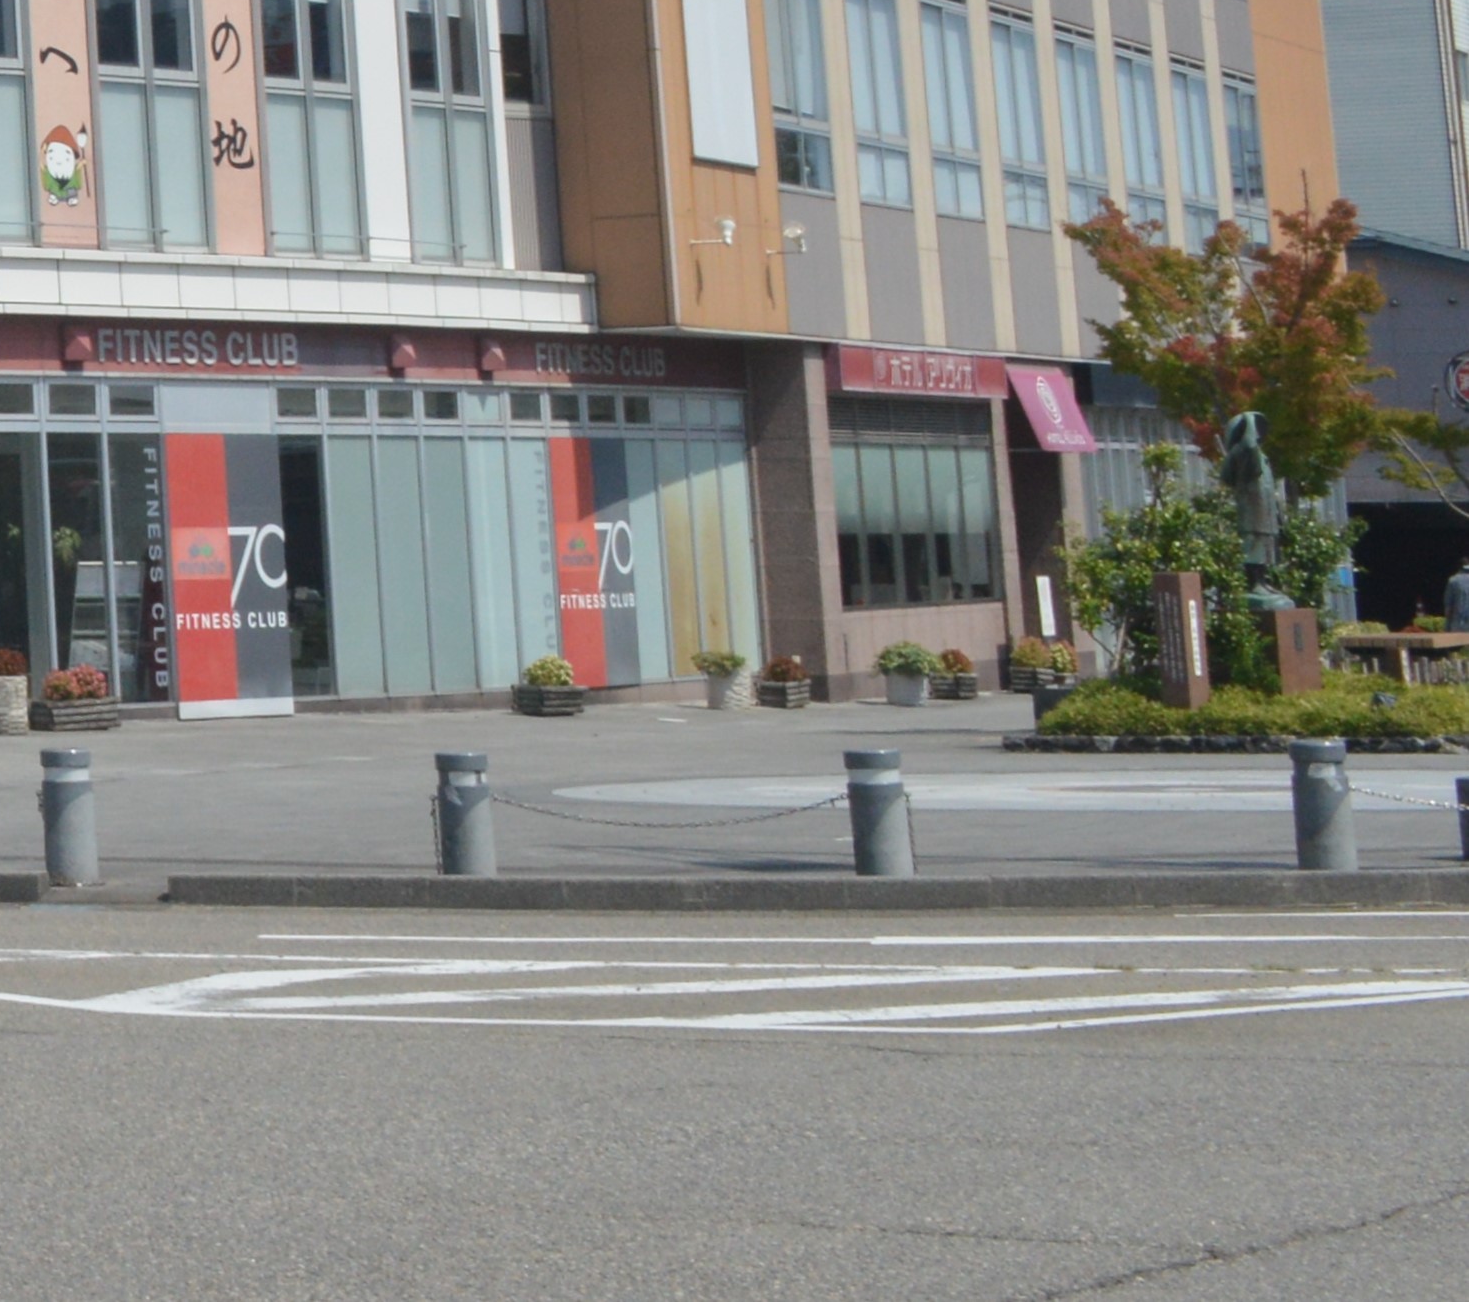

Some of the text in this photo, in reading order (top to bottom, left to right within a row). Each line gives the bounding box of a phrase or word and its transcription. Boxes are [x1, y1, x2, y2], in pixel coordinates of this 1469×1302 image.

[97, 327, 299, 368] FITNESS CLUB
[535, 342, 666, 379] FITNESS CLUB
[890, 356, 924, 388] ホテル
[143, 447, 170, 688] FITNESS CLUB
[593, 519, 635, 591] 70
[559, 591, 637, 610] FITNESS CLUB
[175, 610, 288, 631] FITNESS CLUB
